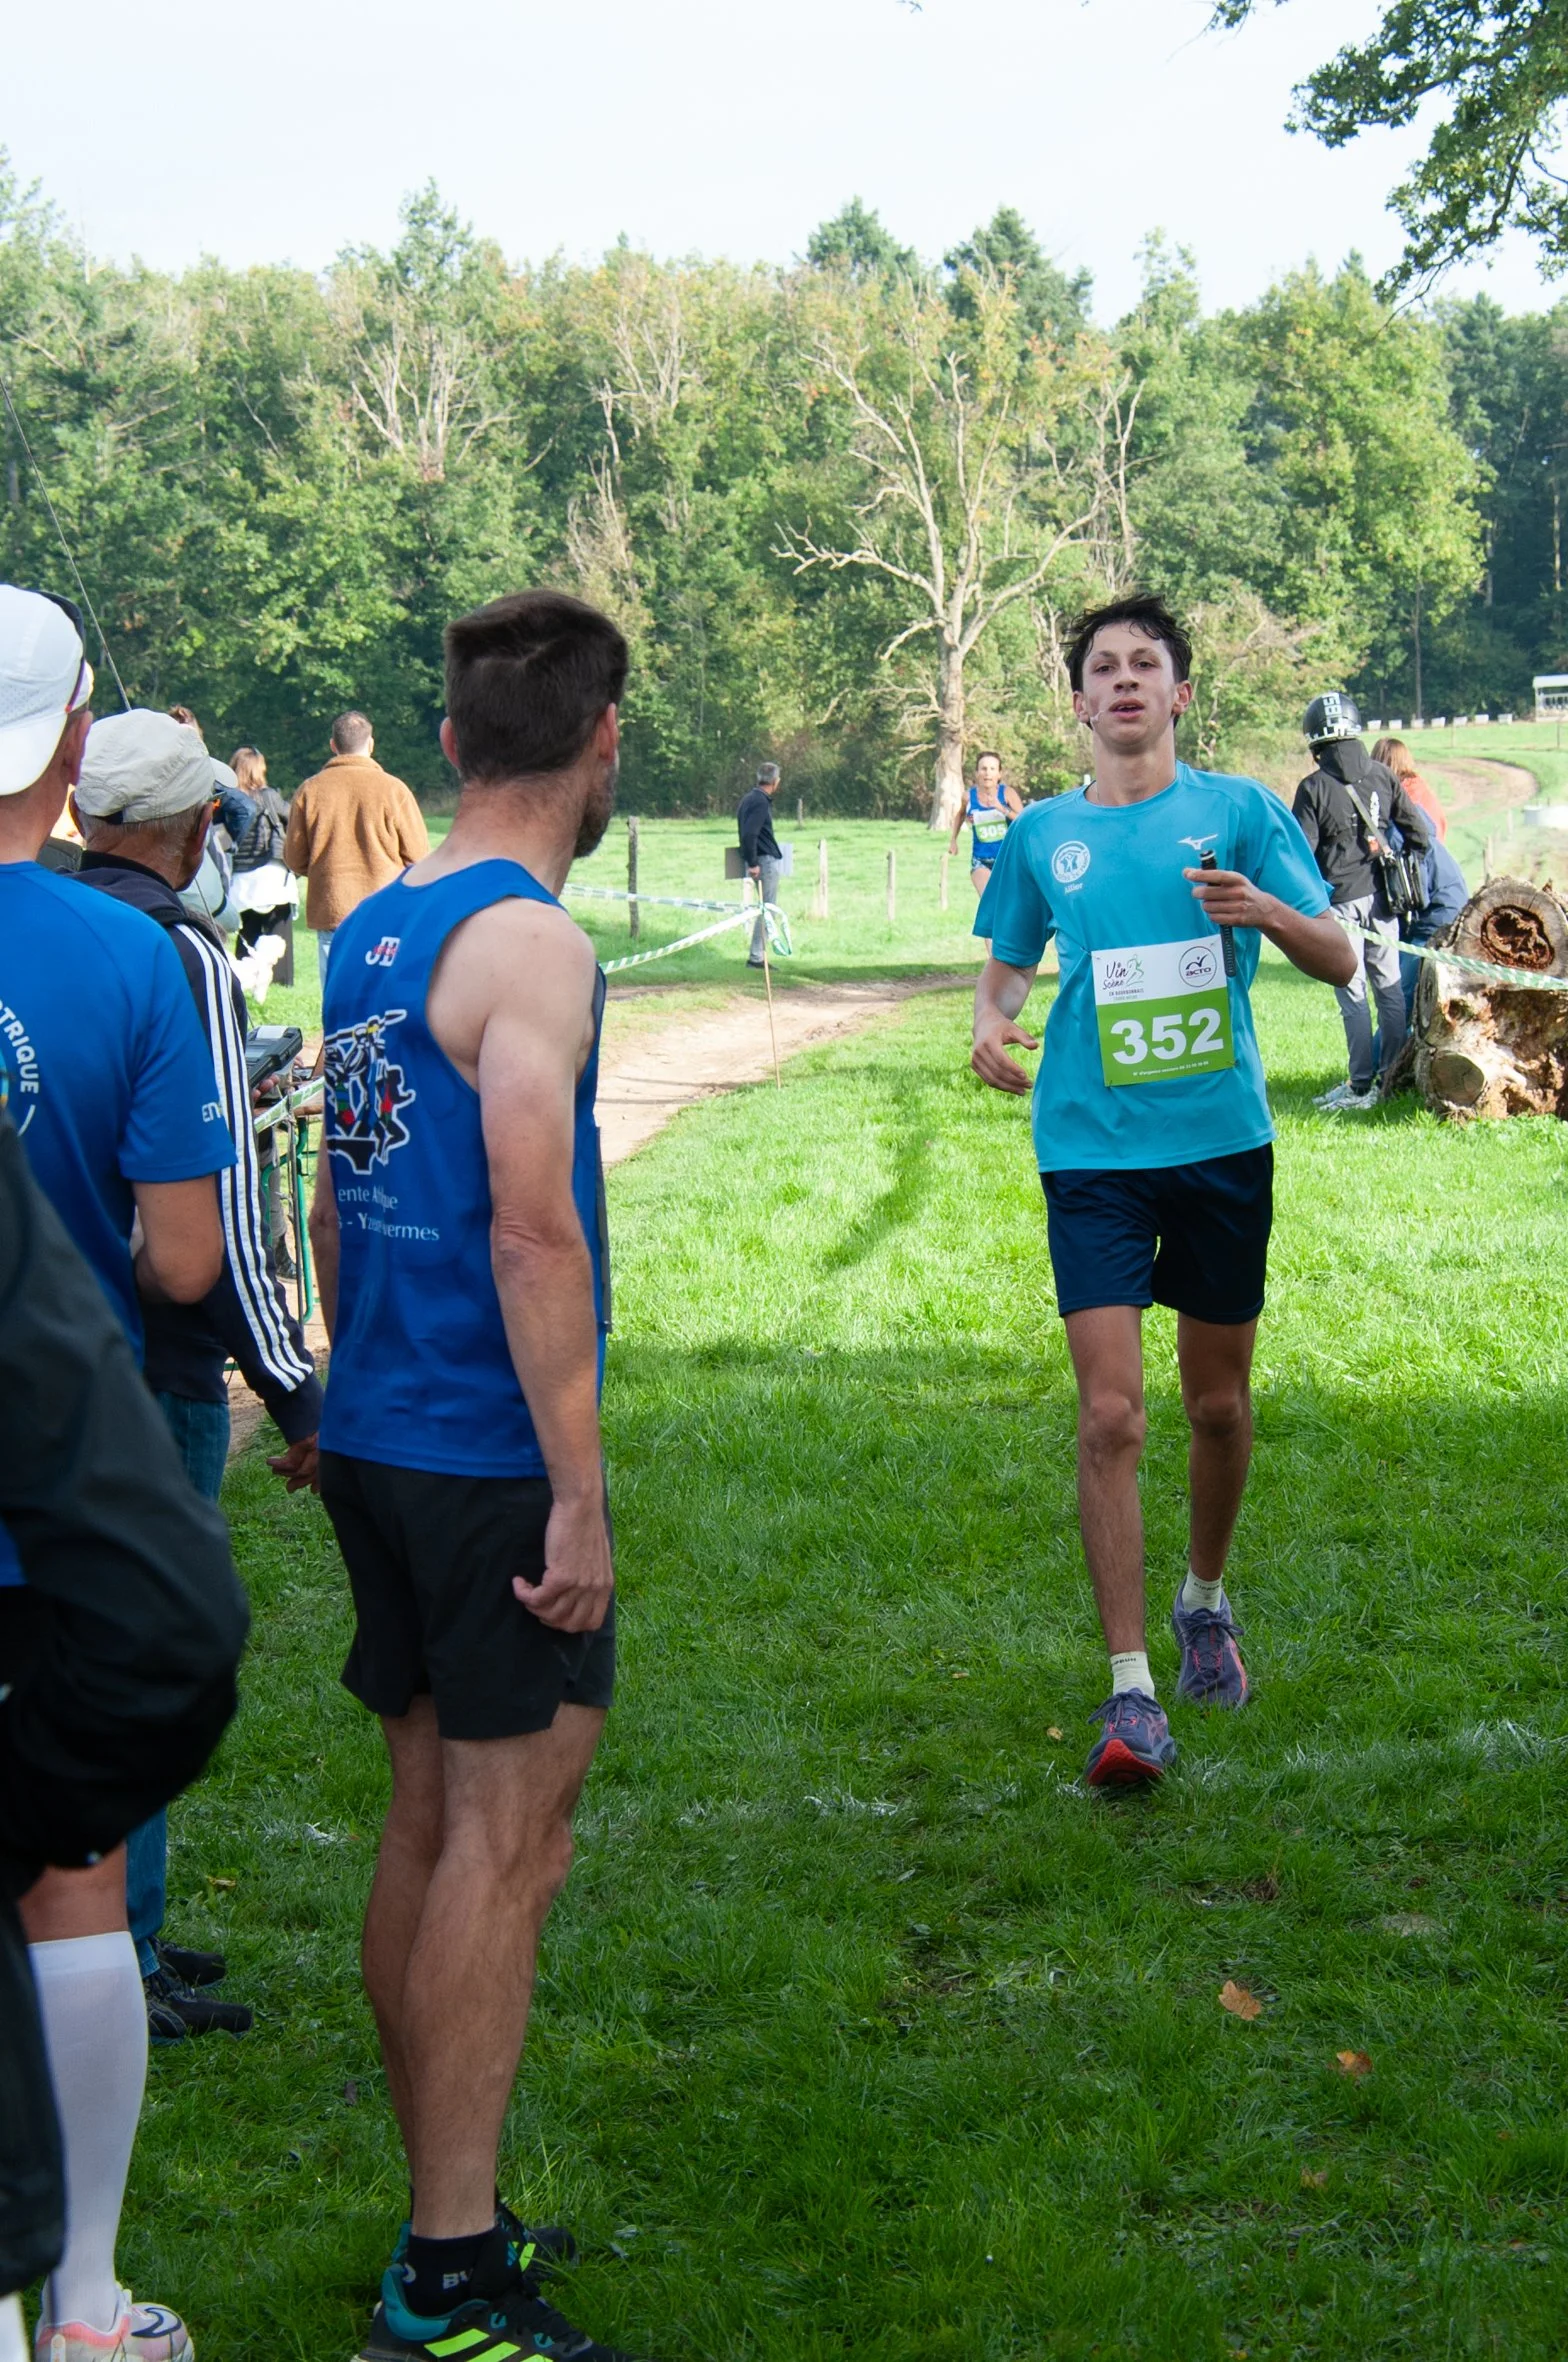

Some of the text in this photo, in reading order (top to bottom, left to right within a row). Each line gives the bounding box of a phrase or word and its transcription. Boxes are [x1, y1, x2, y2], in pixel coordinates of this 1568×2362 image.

[979, 823, 1008, 840] 305
[0, 999, 40, 1095] TRIQUE
[1110, 1007, 1225, 1066] 352
